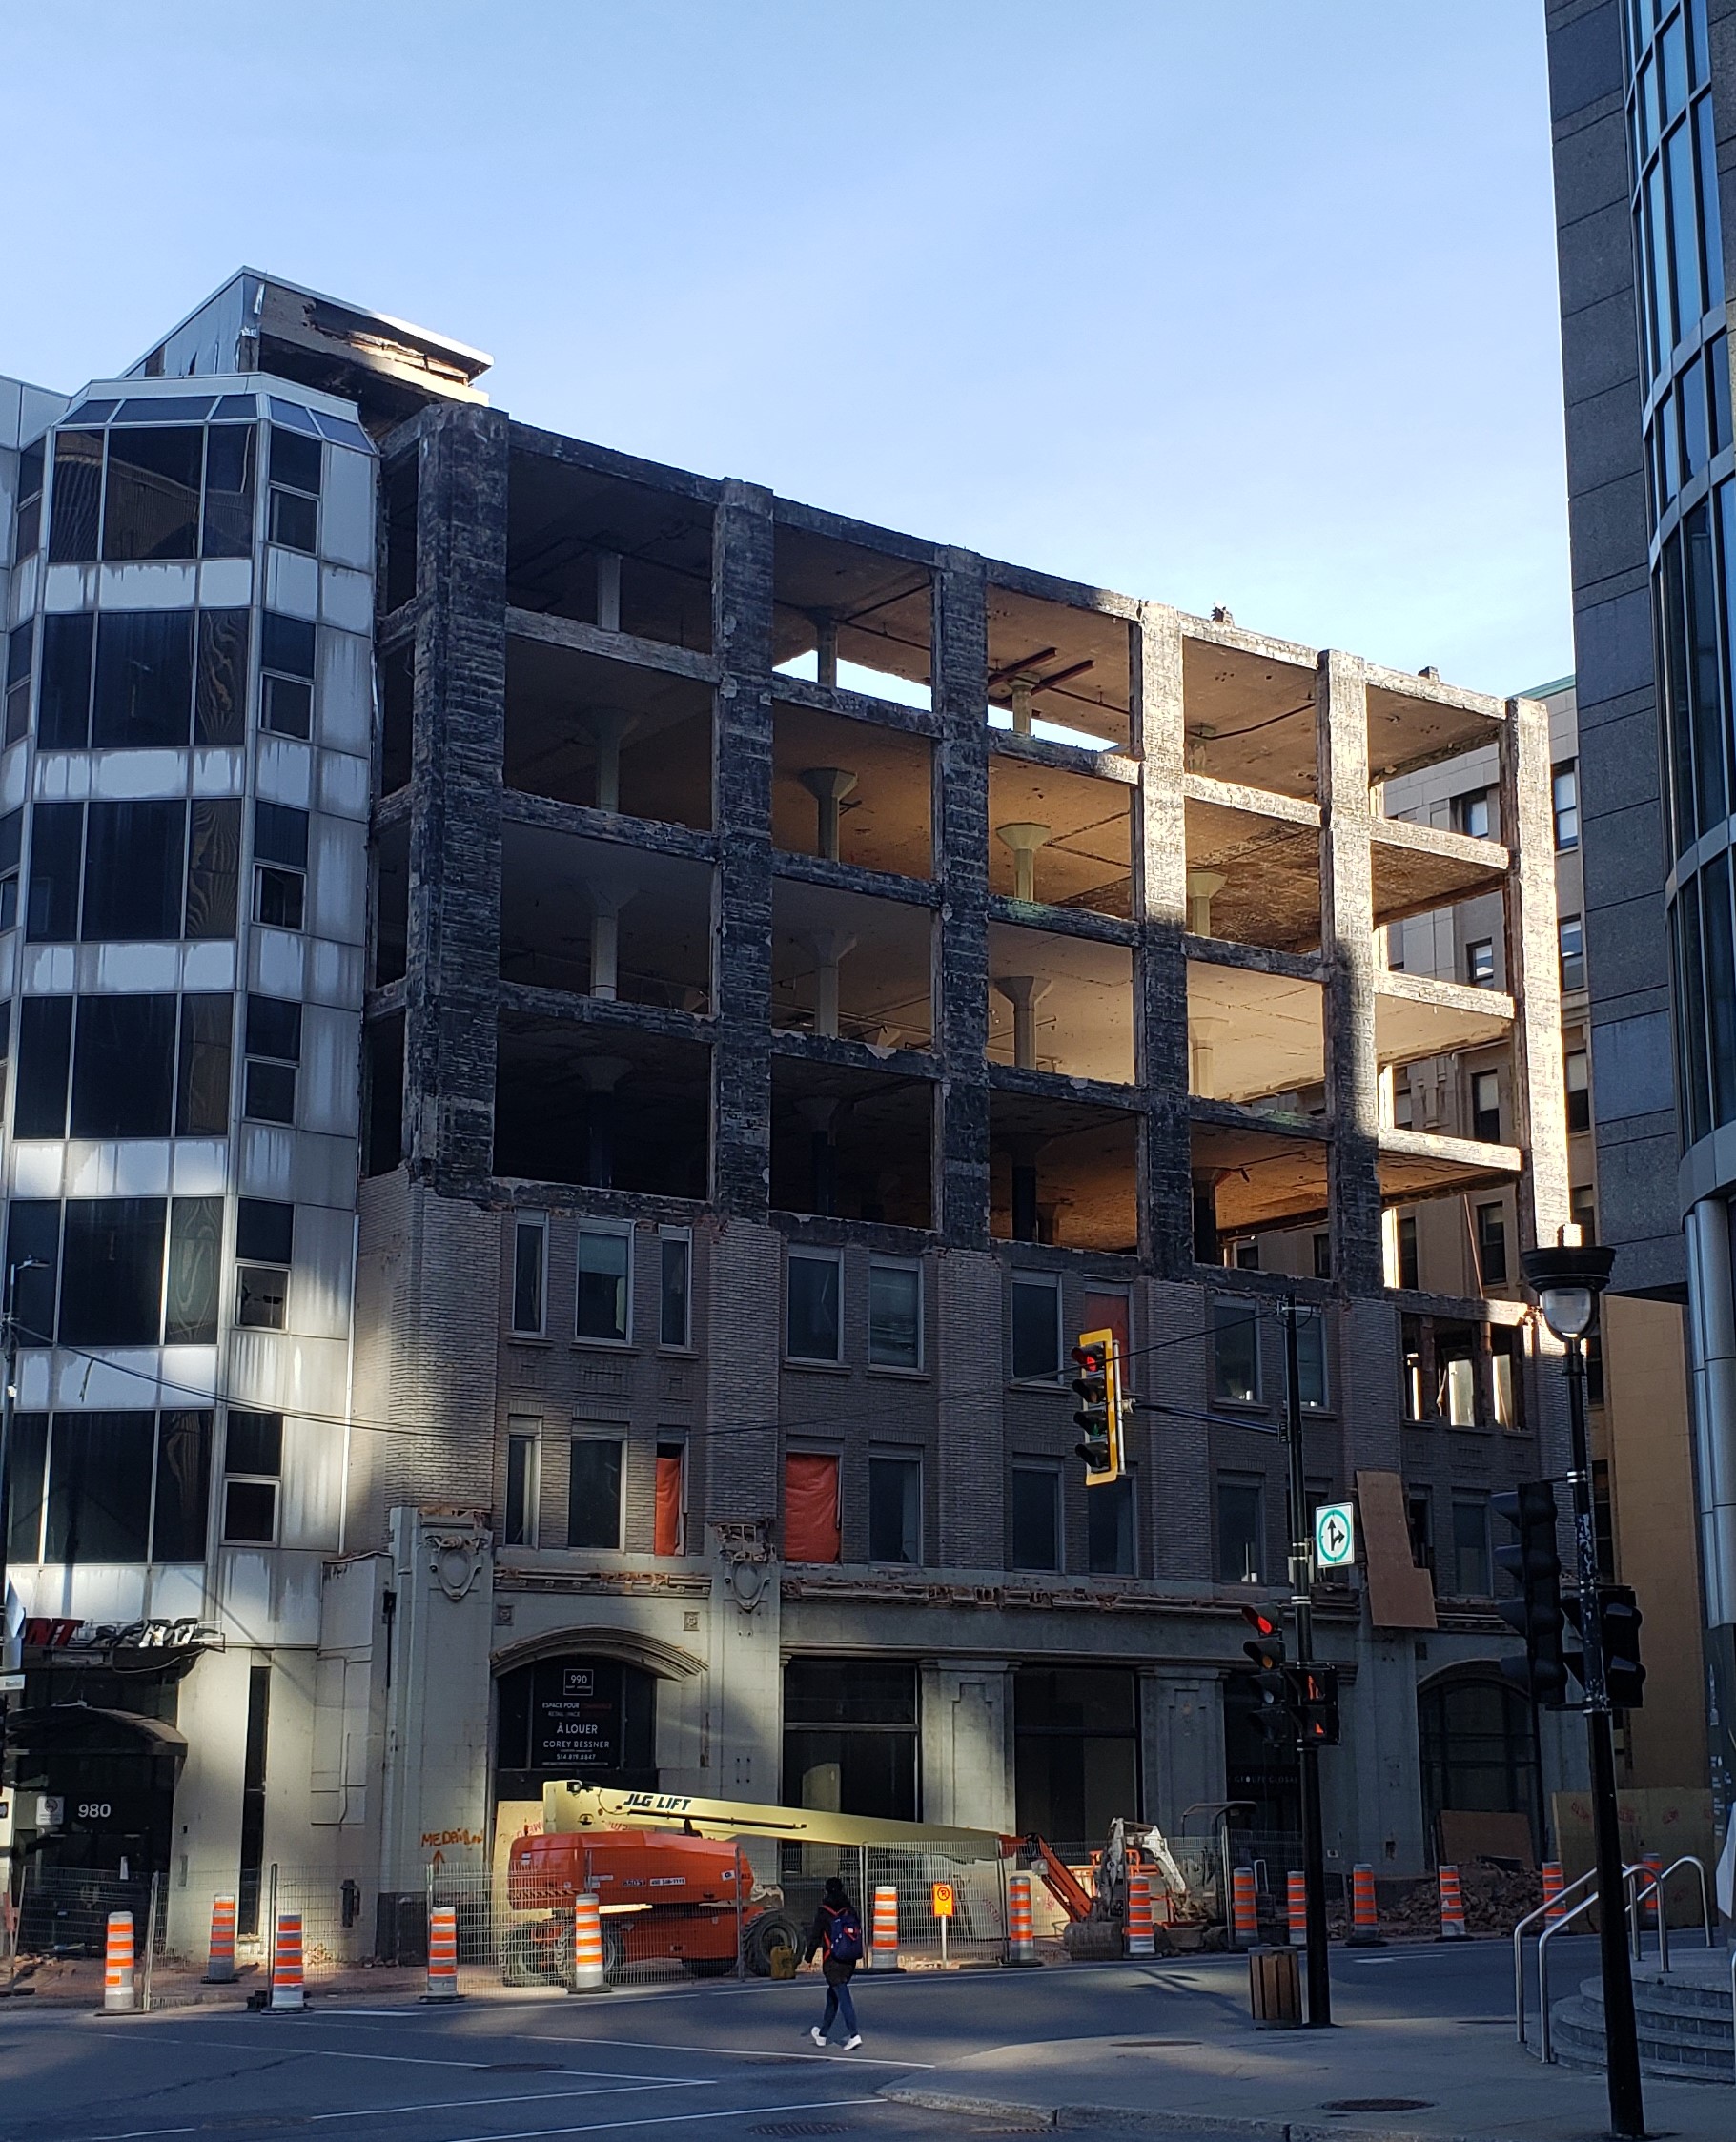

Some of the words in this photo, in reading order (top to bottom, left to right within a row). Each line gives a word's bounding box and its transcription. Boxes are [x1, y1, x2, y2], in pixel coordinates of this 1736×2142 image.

[571, 1675, 587, 1683] 990
[557, 1722, 563, 1733] À
[566, 1724, 598, 1733] LOUER
[623, 1794, 652, 1806] JLG
[656, 1797, 691, 1810] LIFT
[78, 1804, 111, 1817] 980
